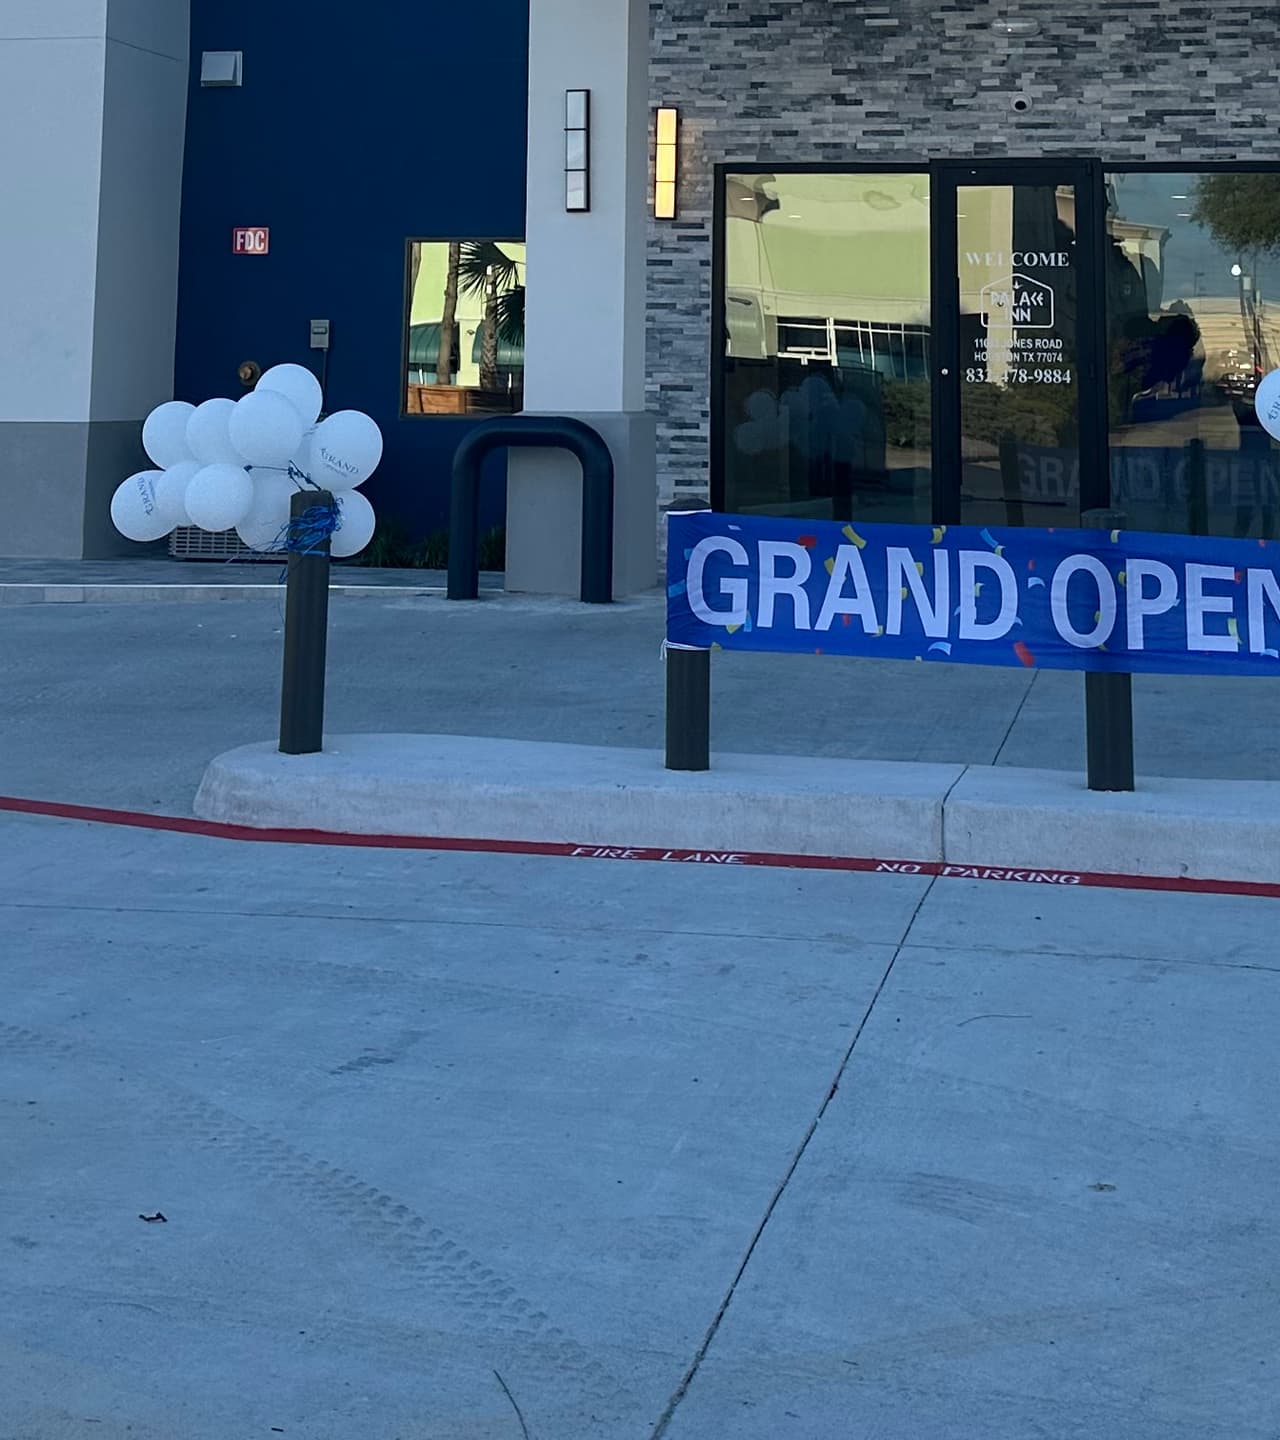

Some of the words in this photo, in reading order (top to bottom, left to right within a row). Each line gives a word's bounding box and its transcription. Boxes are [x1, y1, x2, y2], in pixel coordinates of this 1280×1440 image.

[236, 230, 265, 251] FDC
[966, 252, 1069, 267] WELCOME
[991, 291, 1044, 306] PALACE
[974, 338, 998, 348] 110
[1035, 339, 1063, 349] ROAD
[974, 351, 1020, 362] HOON
[1022, 352, 1035, 362] TX
[966, 368, 1072, 384] 83478-9884
[686, 535, 1019, 641] GRAND
[571, 846, 647, 859] FIRE
[662, 851, 750, 865] LANE
[875, 862, 922, 874] NO
[942, 865, 1081, 884] PARKING
